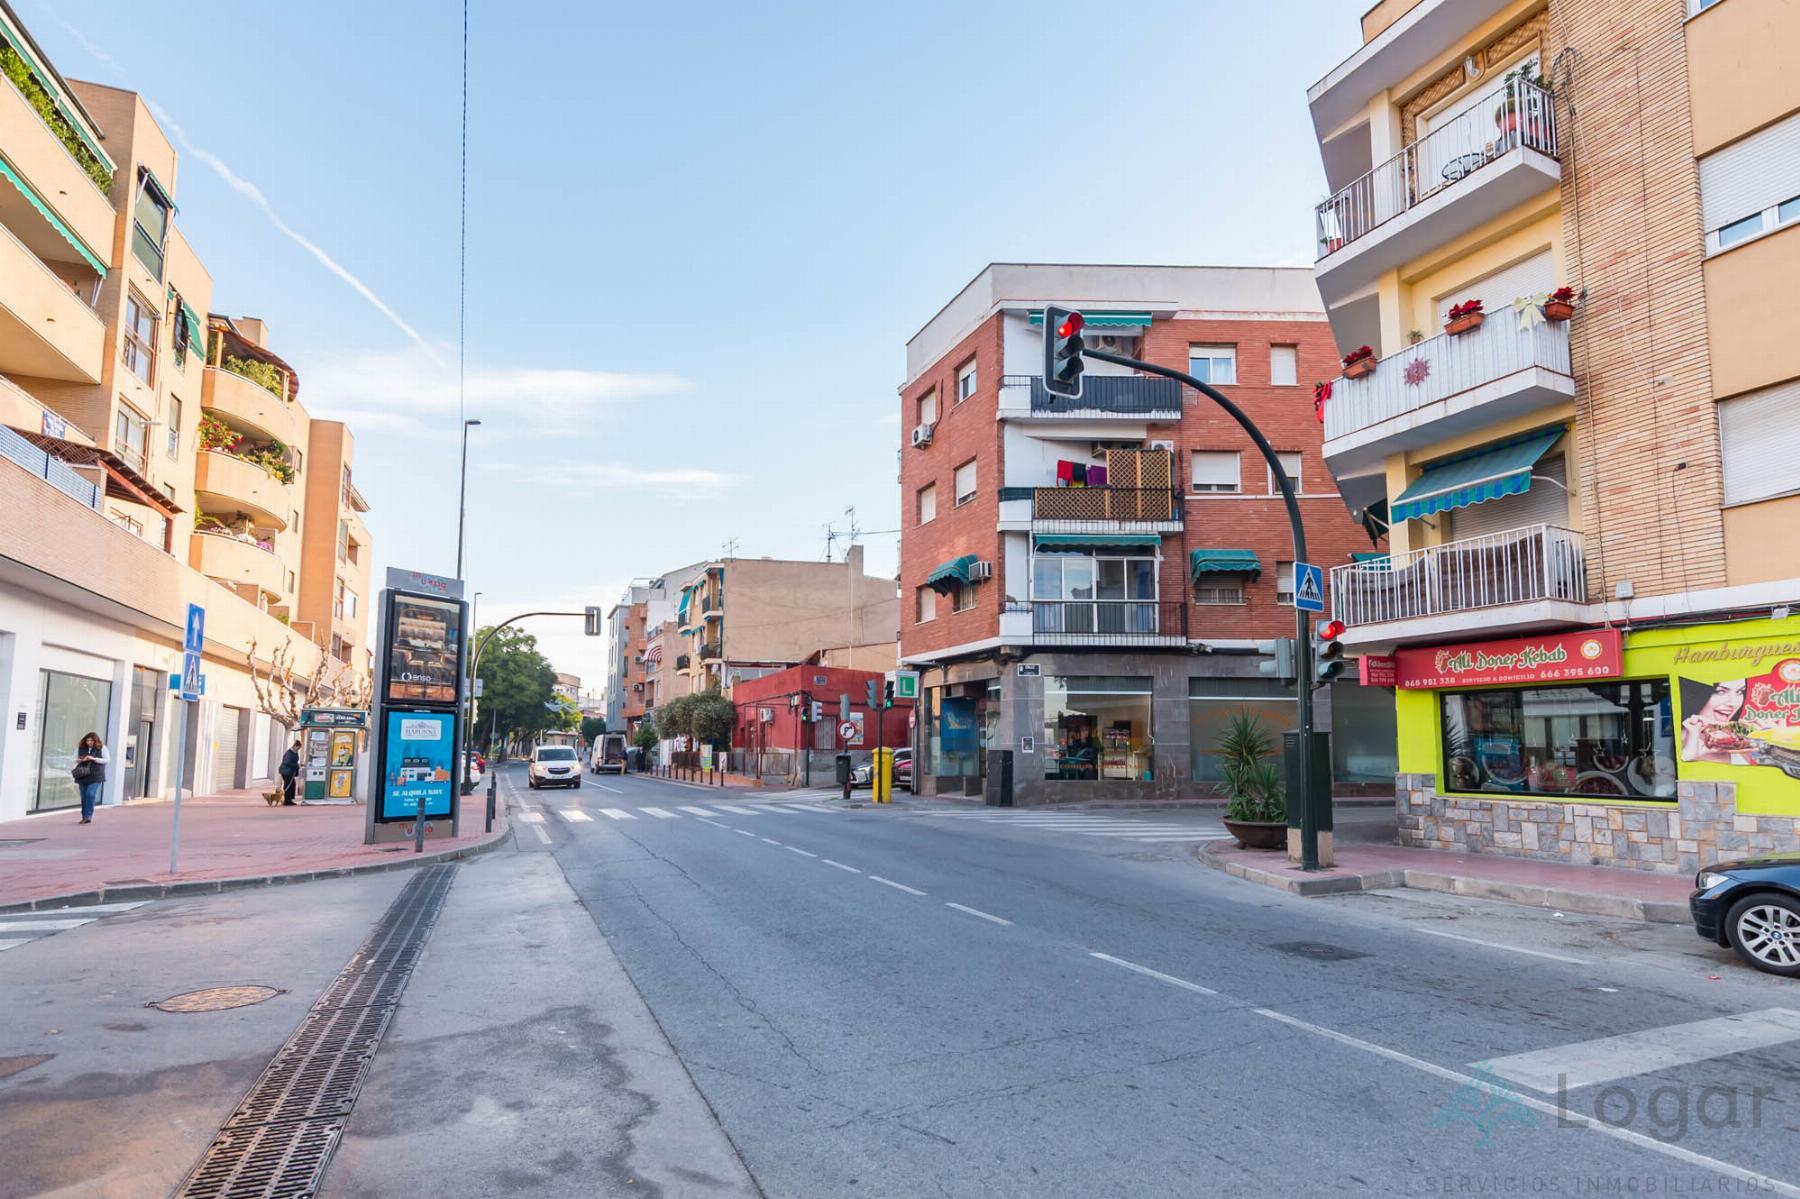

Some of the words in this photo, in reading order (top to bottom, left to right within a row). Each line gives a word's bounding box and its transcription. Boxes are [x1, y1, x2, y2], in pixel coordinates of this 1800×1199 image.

[1448, 650, 1474, 673] Ali
[1474, 650, 1518, 671] Doner
[1517, 642, 1567, 668] Kebab
[1499, 673, 1535, 681] DOMICILIO
[1540, 669, 1560, 679] 666
[1563, 668, 1583, 676] 395
[1588, 666, 1609, 675] 600
[902, 680, 912, 694] L
[1744, 704, 1790, 721] Doner
